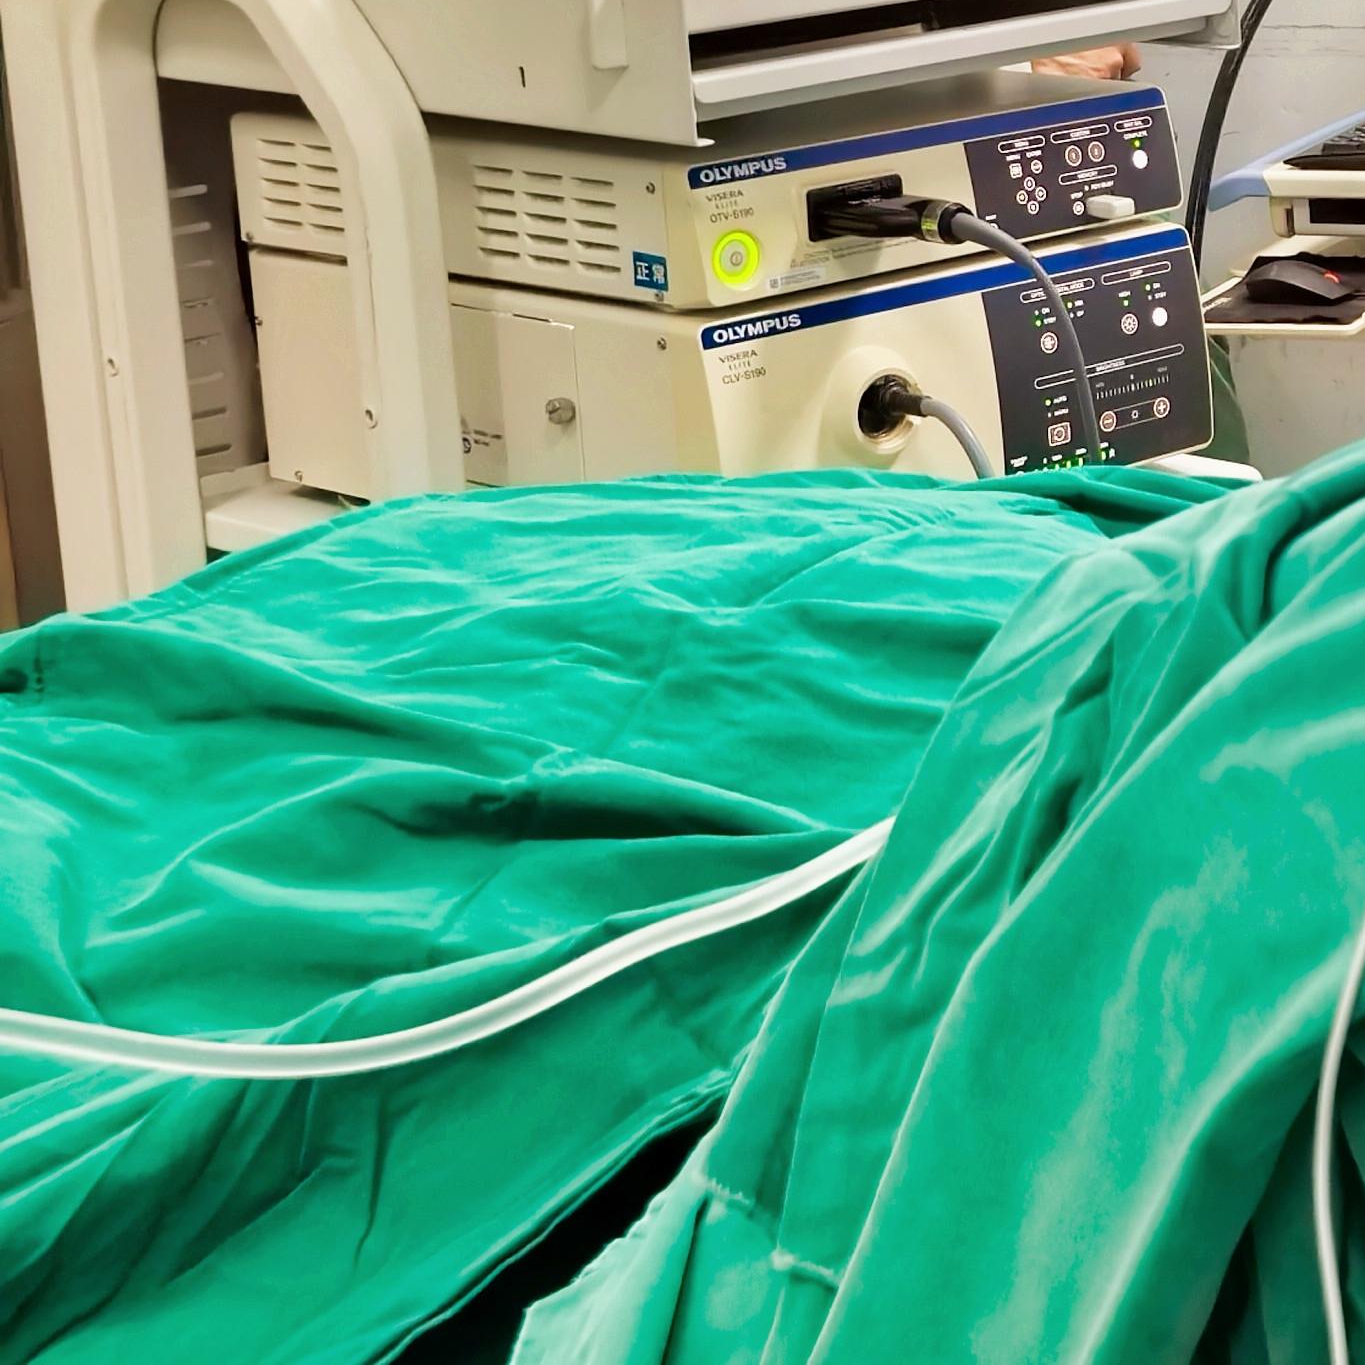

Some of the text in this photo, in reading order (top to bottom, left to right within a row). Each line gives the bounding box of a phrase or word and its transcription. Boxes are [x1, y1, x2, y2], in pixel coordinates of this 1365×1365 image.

[700, 157, 787, 183] OLYMPUS
[706, 189, 744, 202] VISERA
[635, 261, 666, 284] 正常
[713, 314, 802, 343] OLYMPUS
[718, 349, 758, 364] VISERA
